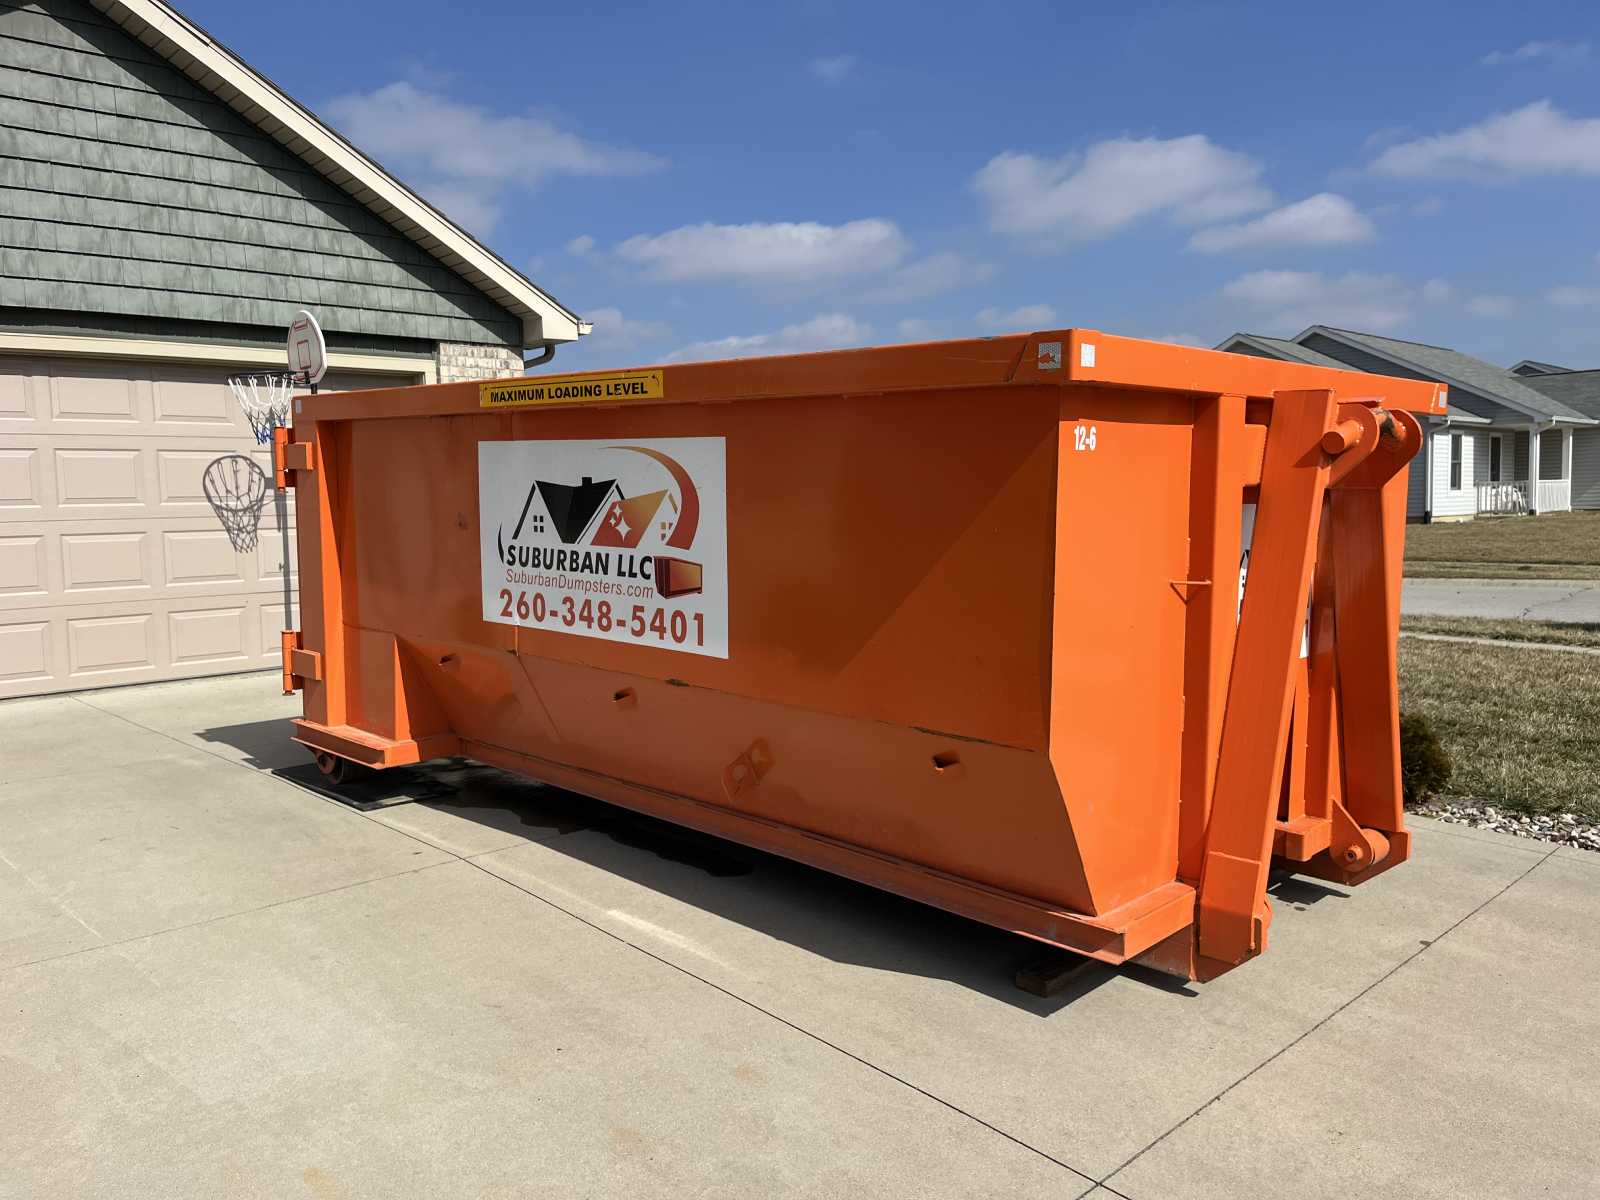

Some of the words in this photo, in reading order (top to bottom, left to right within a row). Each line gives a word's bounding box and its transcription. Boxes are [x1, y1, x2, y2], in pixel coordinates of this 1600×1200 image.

[490, 388, 544, 403] MAXIMUM
[548, 384, 602, 399] LOADING
[606, 382, 649, 396] LEVEL
[1074, 425, 1097, 451] 12-6
[506, 544, 609, 576] SUBURBAN
[617, 553, 653, 580] LLC
[505, 568, 654, 599] SuburbanDumpsters.com
[499, 588, 704, 646] 260-348-5401
